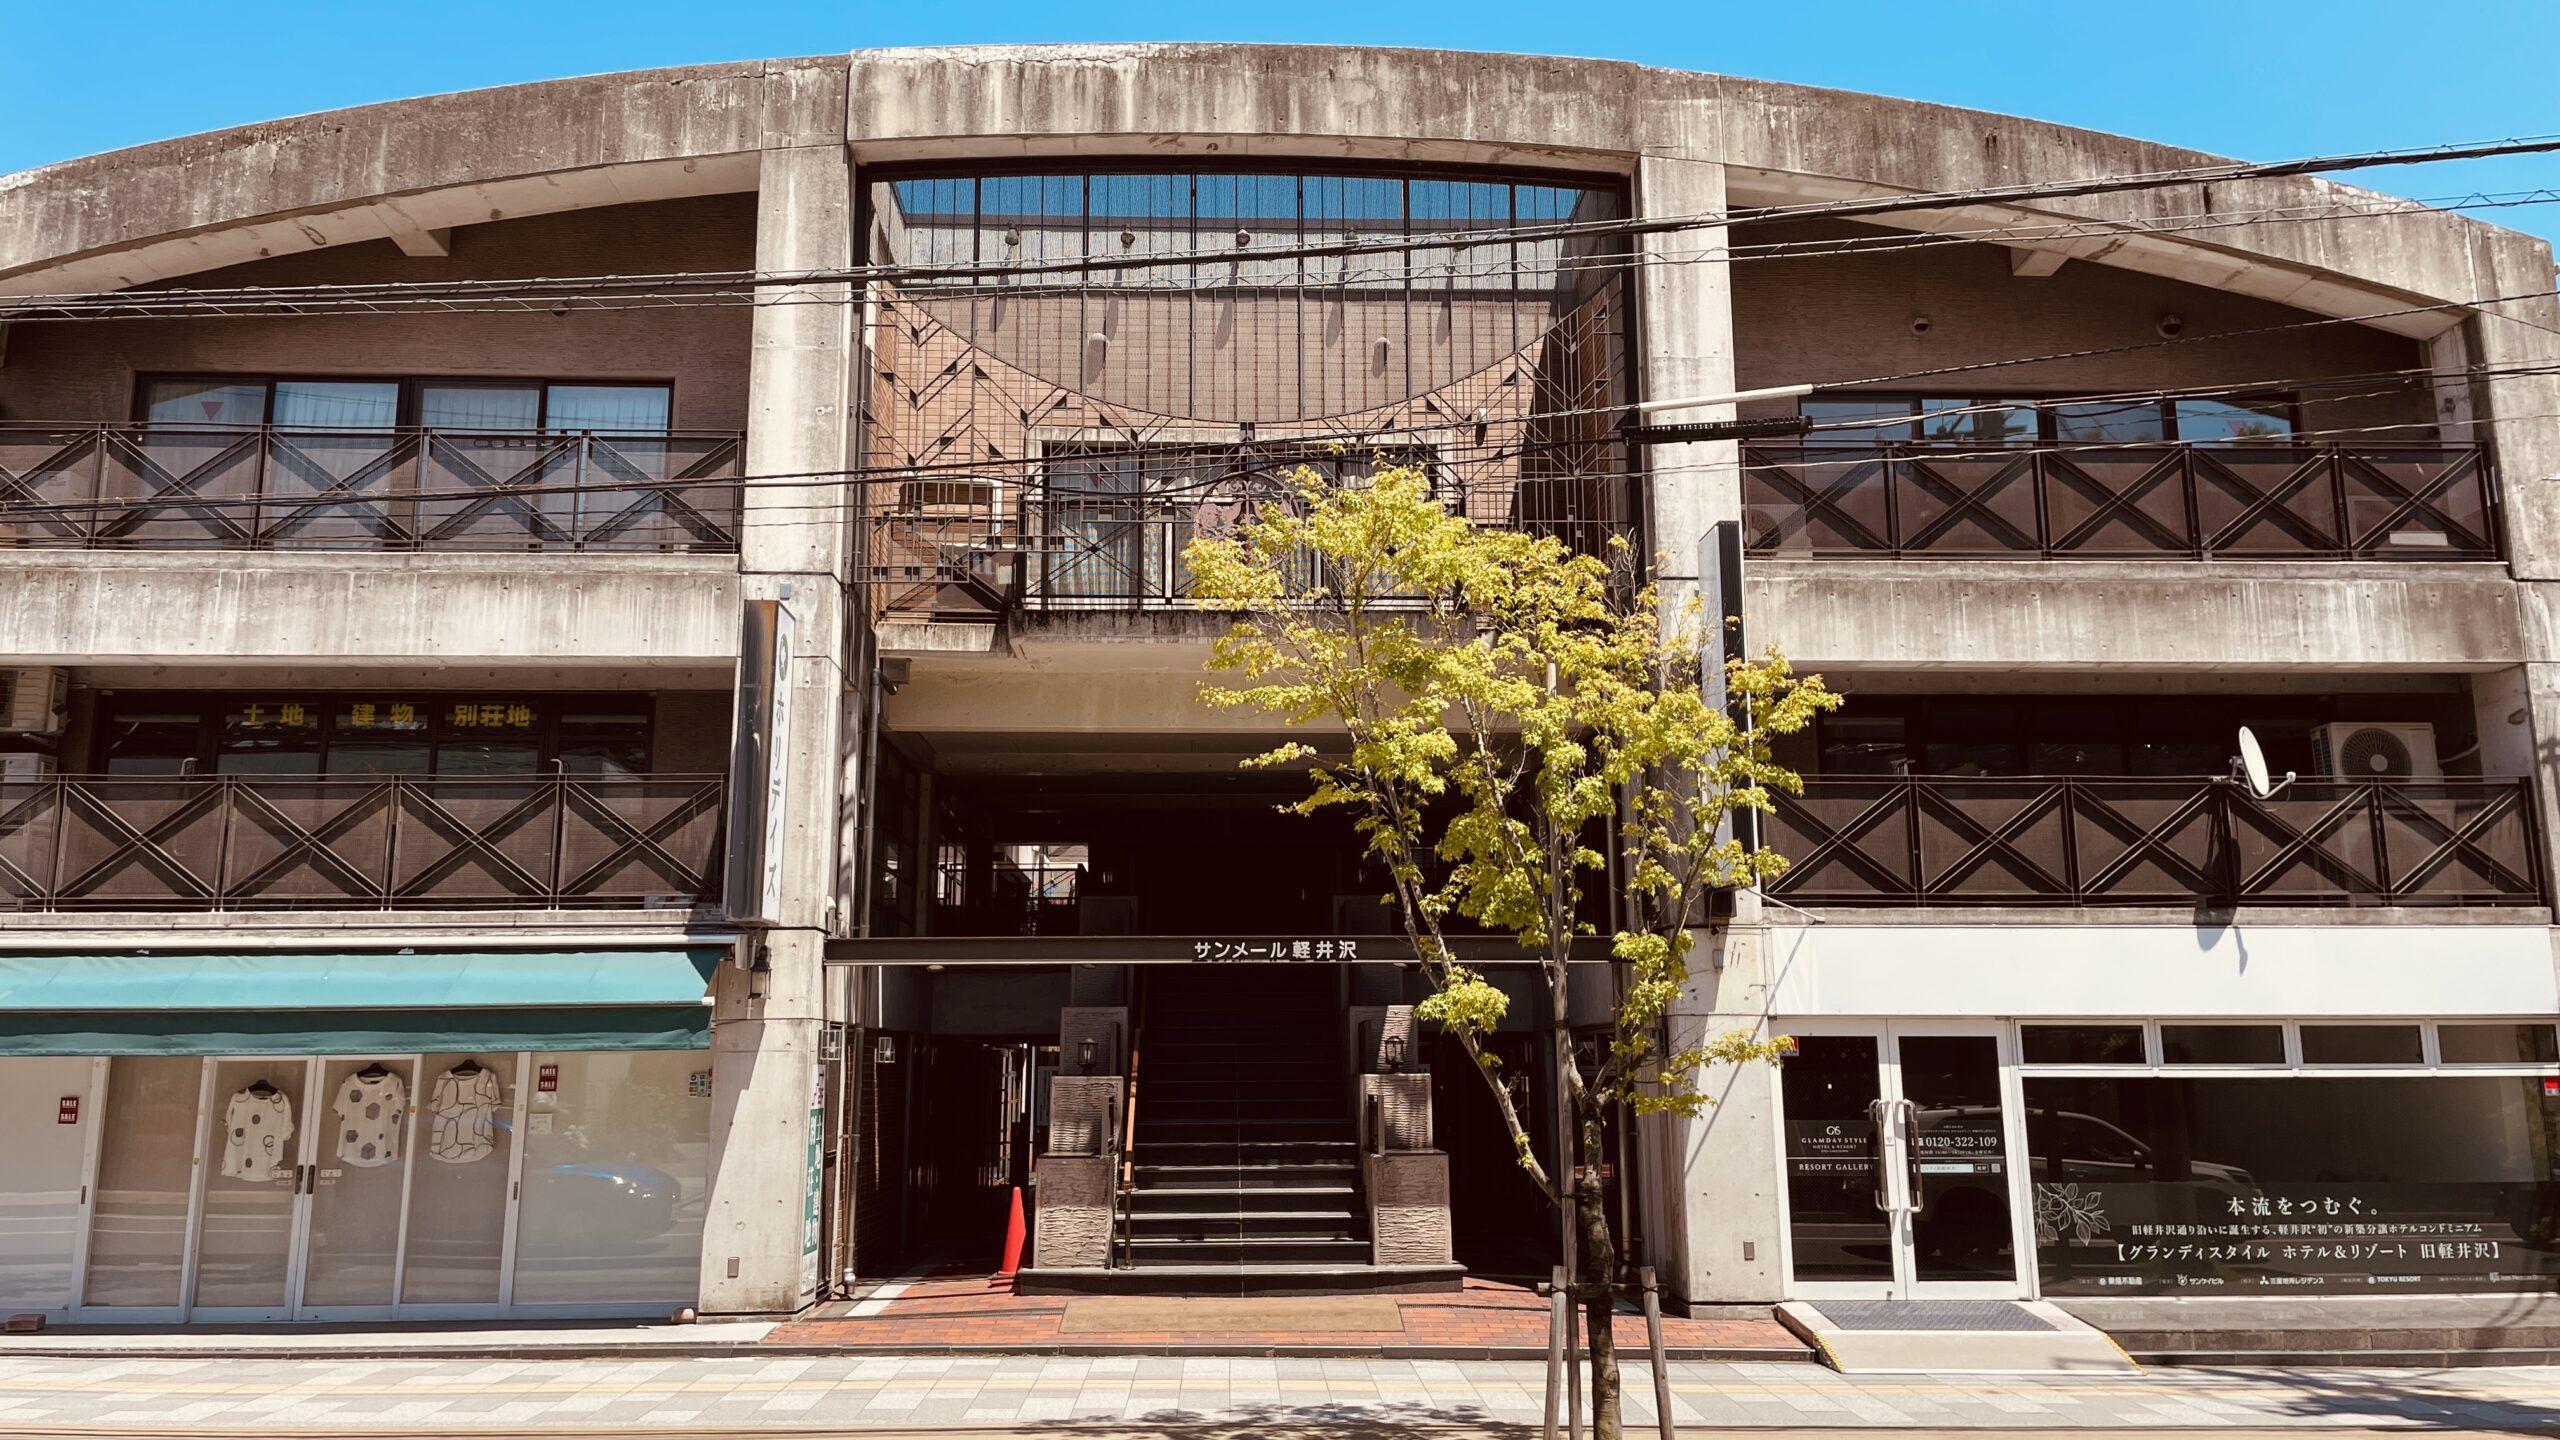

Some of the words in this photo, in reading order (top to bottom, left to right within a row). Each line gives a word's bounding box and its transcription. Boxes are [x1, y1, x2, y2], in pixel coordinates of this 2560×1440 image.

[453, 703, 531, 728] 別荘地
[1194, 940, 1357, 959] サンメール軽井沢
[1925, 1136, 1998, 1147] 0120-322-109
[1799, 1163, 1833, 1171] RESORT
[1835, 1163, 1874, 1171] GALLERY
[2226, 1196, 2378, 1217] 本流をつむぐ。
[2376, 1275, 2398, 1283] TOKYU
[2398, 1275, 2422, 1283] RESORT
